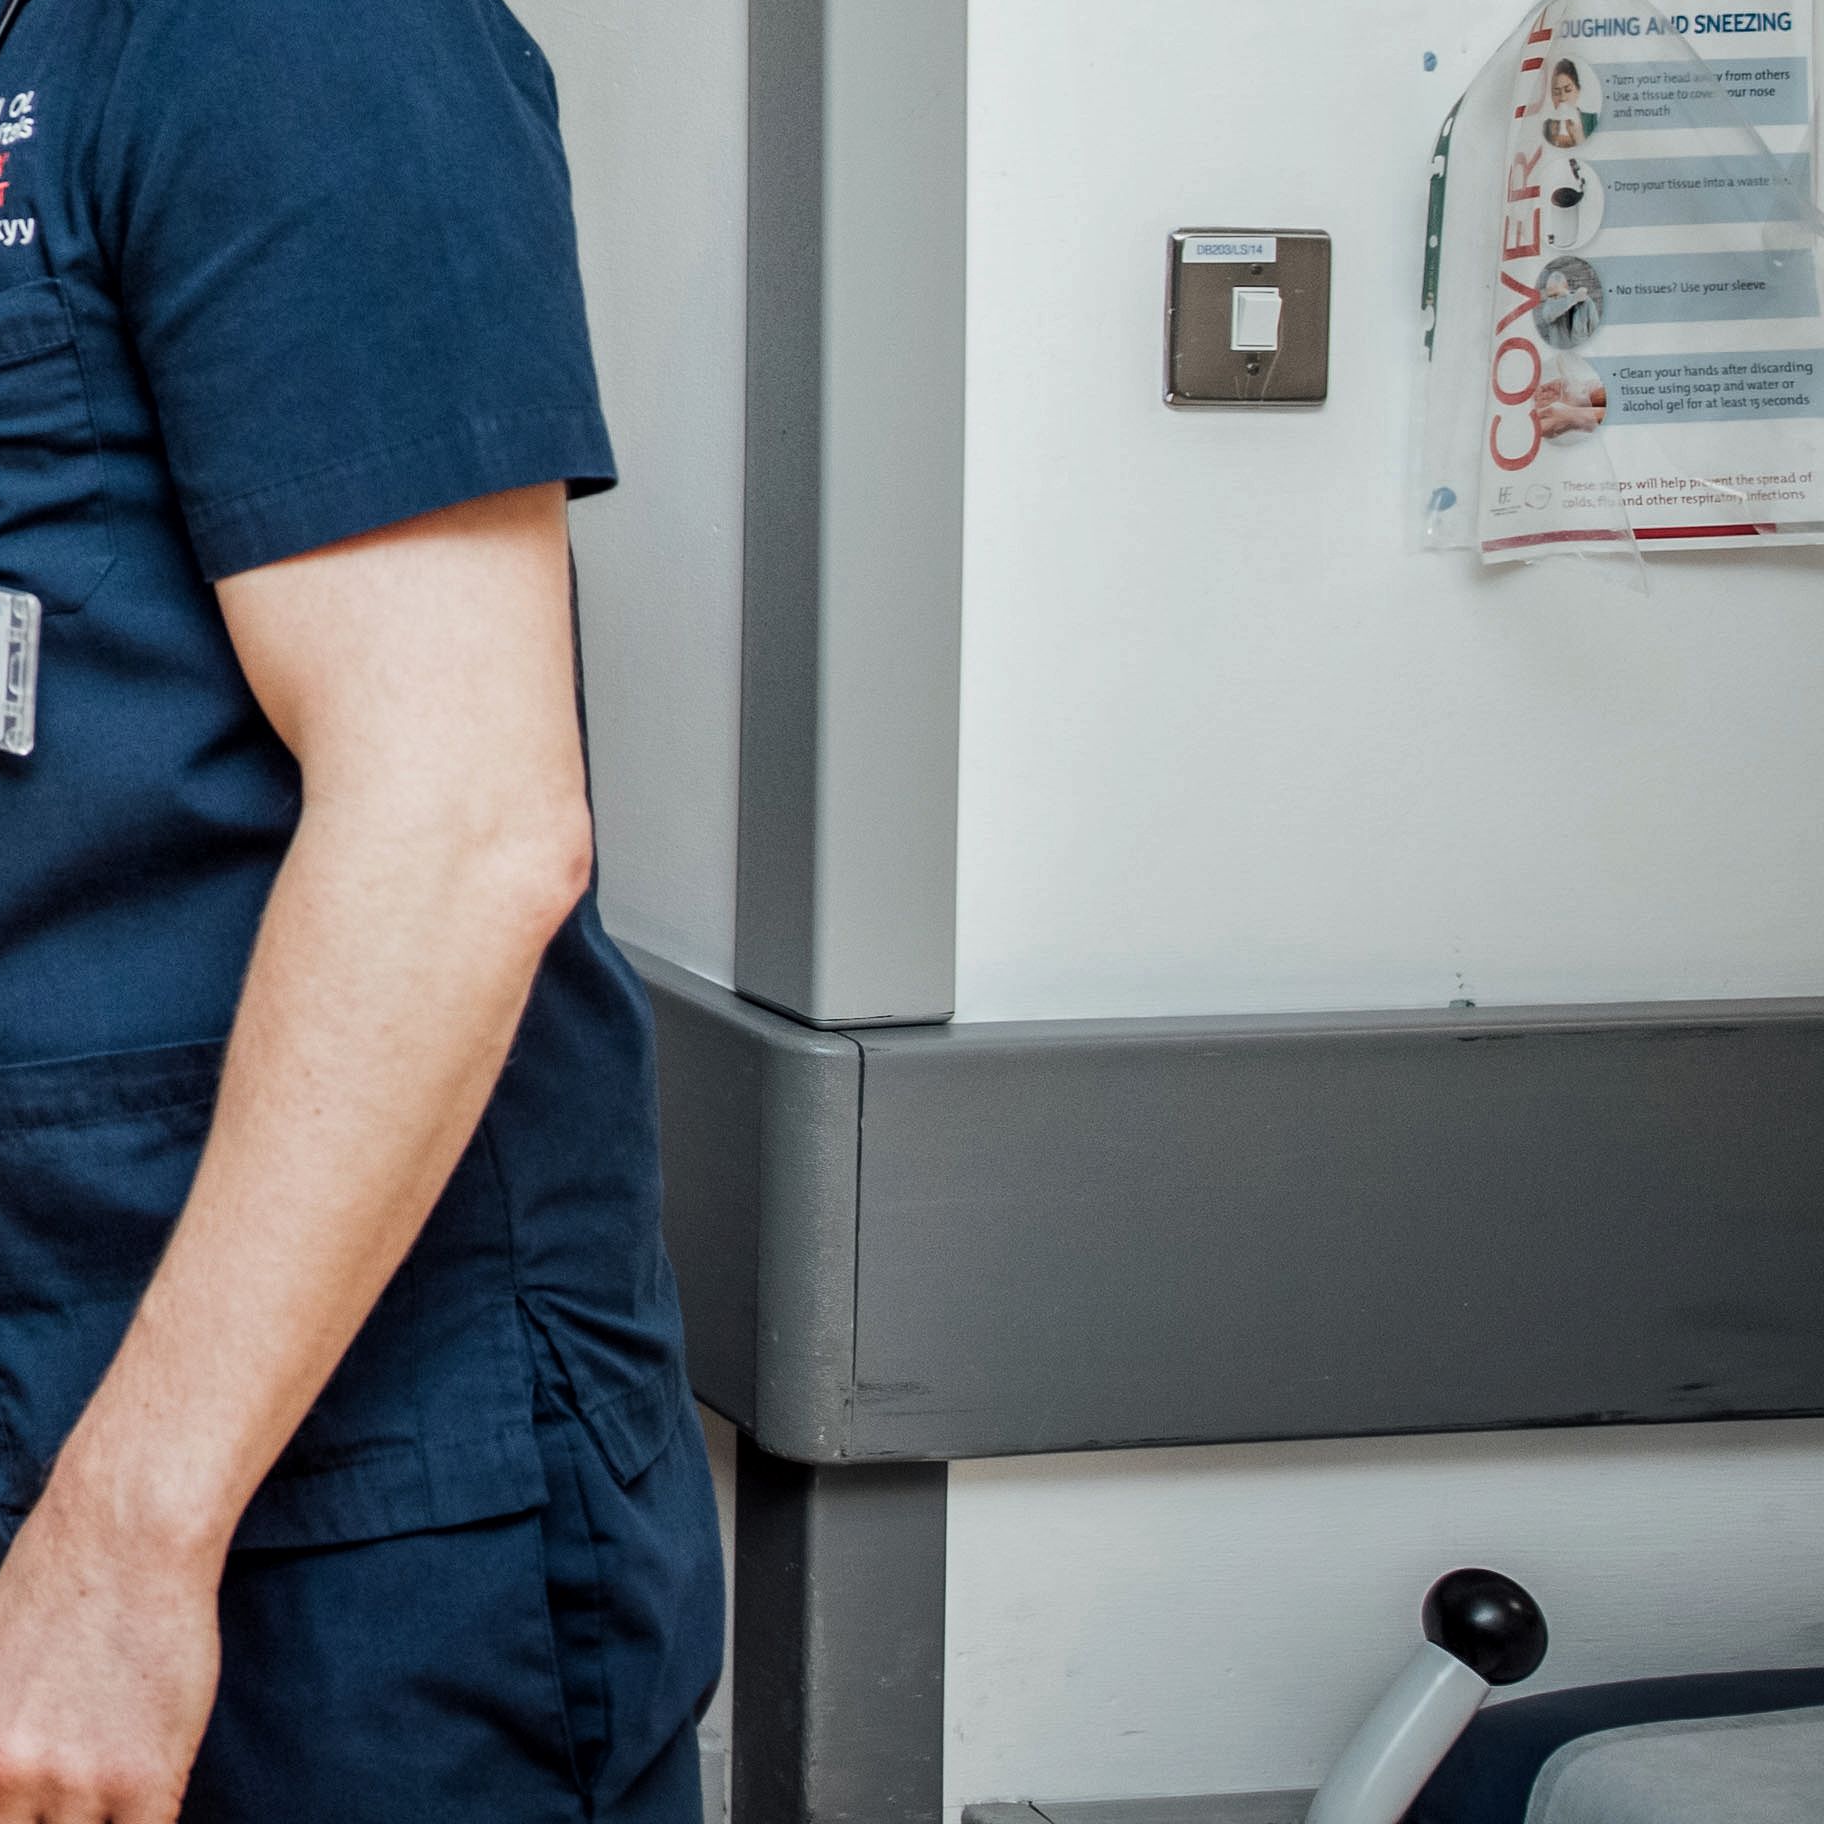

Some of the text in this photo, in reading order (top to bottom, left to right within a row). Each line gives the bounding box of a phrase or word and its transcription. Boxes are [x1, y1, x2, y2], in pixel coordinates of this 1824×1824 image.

[1559, 17, 1641, 38] OUGHING
[1693, 11, 1793, 34] SNEEZING
[1725, 70, 1752, 81] from
[1754, 69, 1791, 81] others
[1726, 88, 1746, 97] our
[1749, 87, 1776, 97] nose
[1614, 180, 1640, 192] Drop
[1641, 180, 1666, 194] your
[1668, 178, 1701, 189] tissue
[1703, 176, 1725, 188] into
[1726, 178, 1734, 187] a
[1616, 279, 1766, 295] No tissues? Use your sleeve
[1489, 144, 1544, 472] COVER
[1620, 361, 1814, 381] Clean your hands after discarding
[1621, 379, 1795, 397] tissue using soap and water or
[1622, 398, 1664, 412] alcohol
[1666, 398, 1684, 413] gel
[1686, 397, 1702, 409] for
[1704, 397, 1718, 408] at
[1721, 396, 1748, 408] least
[1762, 394, 1810, 407] seconds
[1636, 478, 1657, 489] will
[1660, 476, 1687, 490] help
[1736, 474, 1754, 485] the
[1756, 473, 1796, 486] spread
[1799, 472, 1812, 483] of
[1646, 494, 1678, 505] other
[1747, 489, 1806, 502] infections
